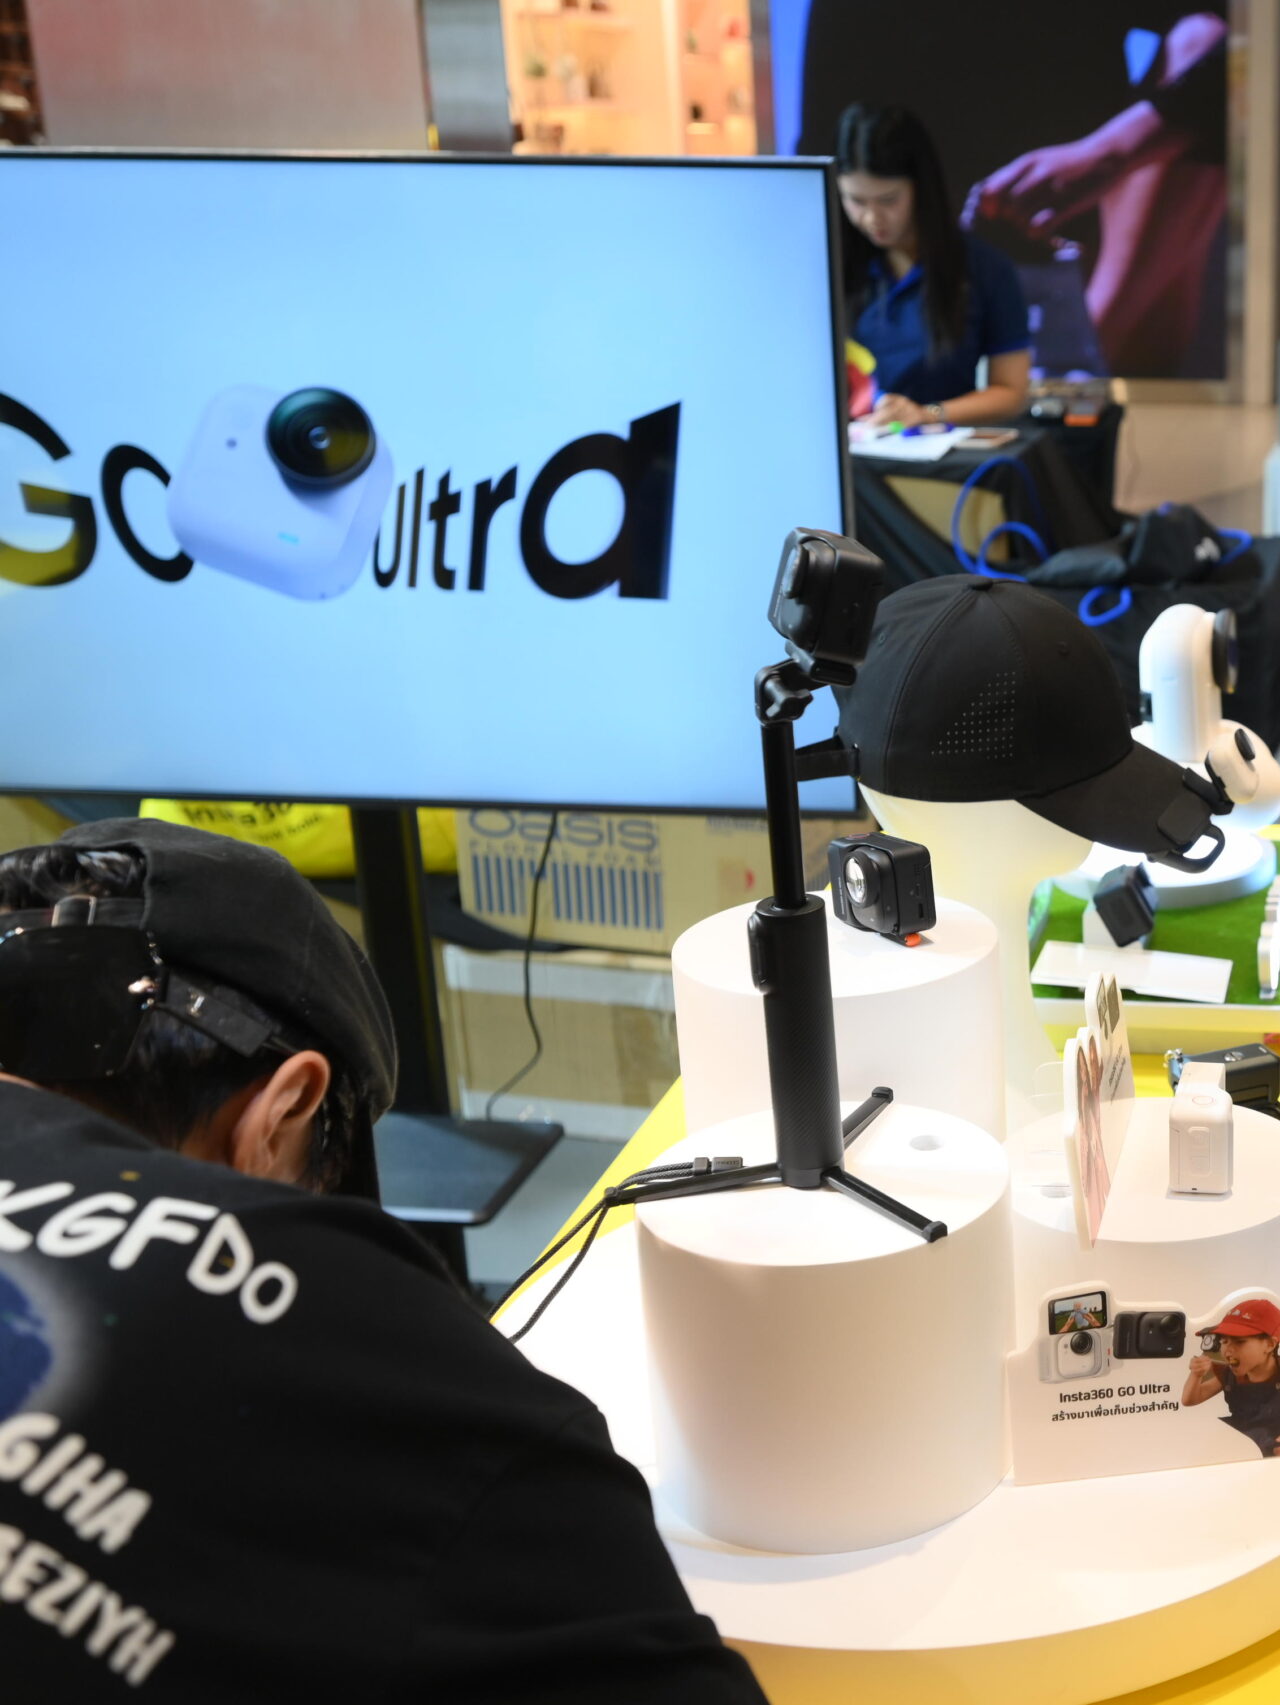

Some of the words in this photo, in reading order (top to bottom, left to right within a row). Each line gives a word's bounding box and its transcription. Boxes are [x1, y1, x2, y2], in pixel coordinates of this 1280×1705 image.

[373, 400, 683, 602] Ultra
[1051, 1400, 1180, 1422] สร้างมาเพื่อเก็บช่วงสำคัญ
[1059, 1388, 1114, 1404] Insta360
[1117, 1385, 1136, 1398] GO
[1139, 1383, 1171, 1396] Ultra
[0, 1522, 177, 1688] EZIYH
